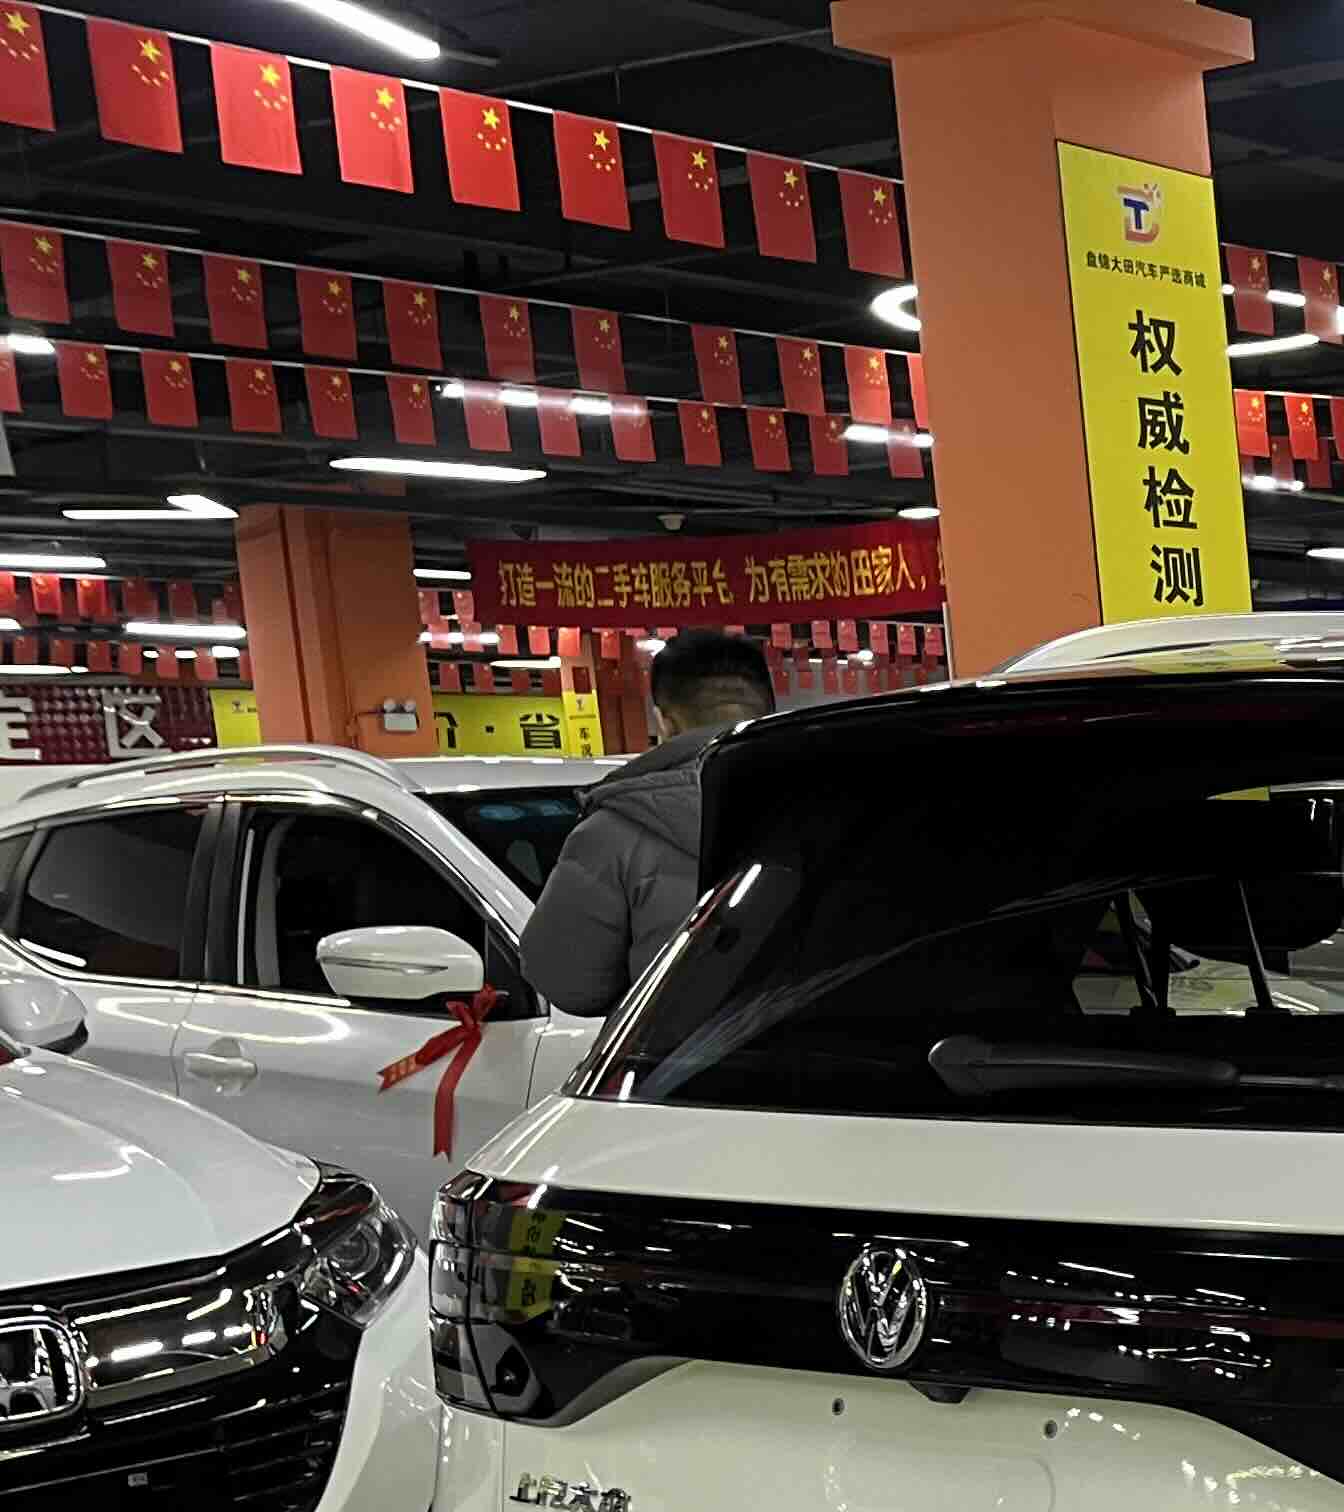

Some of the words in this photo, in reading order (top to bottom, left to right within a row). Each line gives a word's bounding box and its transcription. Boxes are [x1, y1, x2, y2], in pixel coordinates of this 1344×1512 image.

[1128, 308, 1205, 607] 权威检测
[499, 558, 734, 608] 打造一流的二手车服务平台
